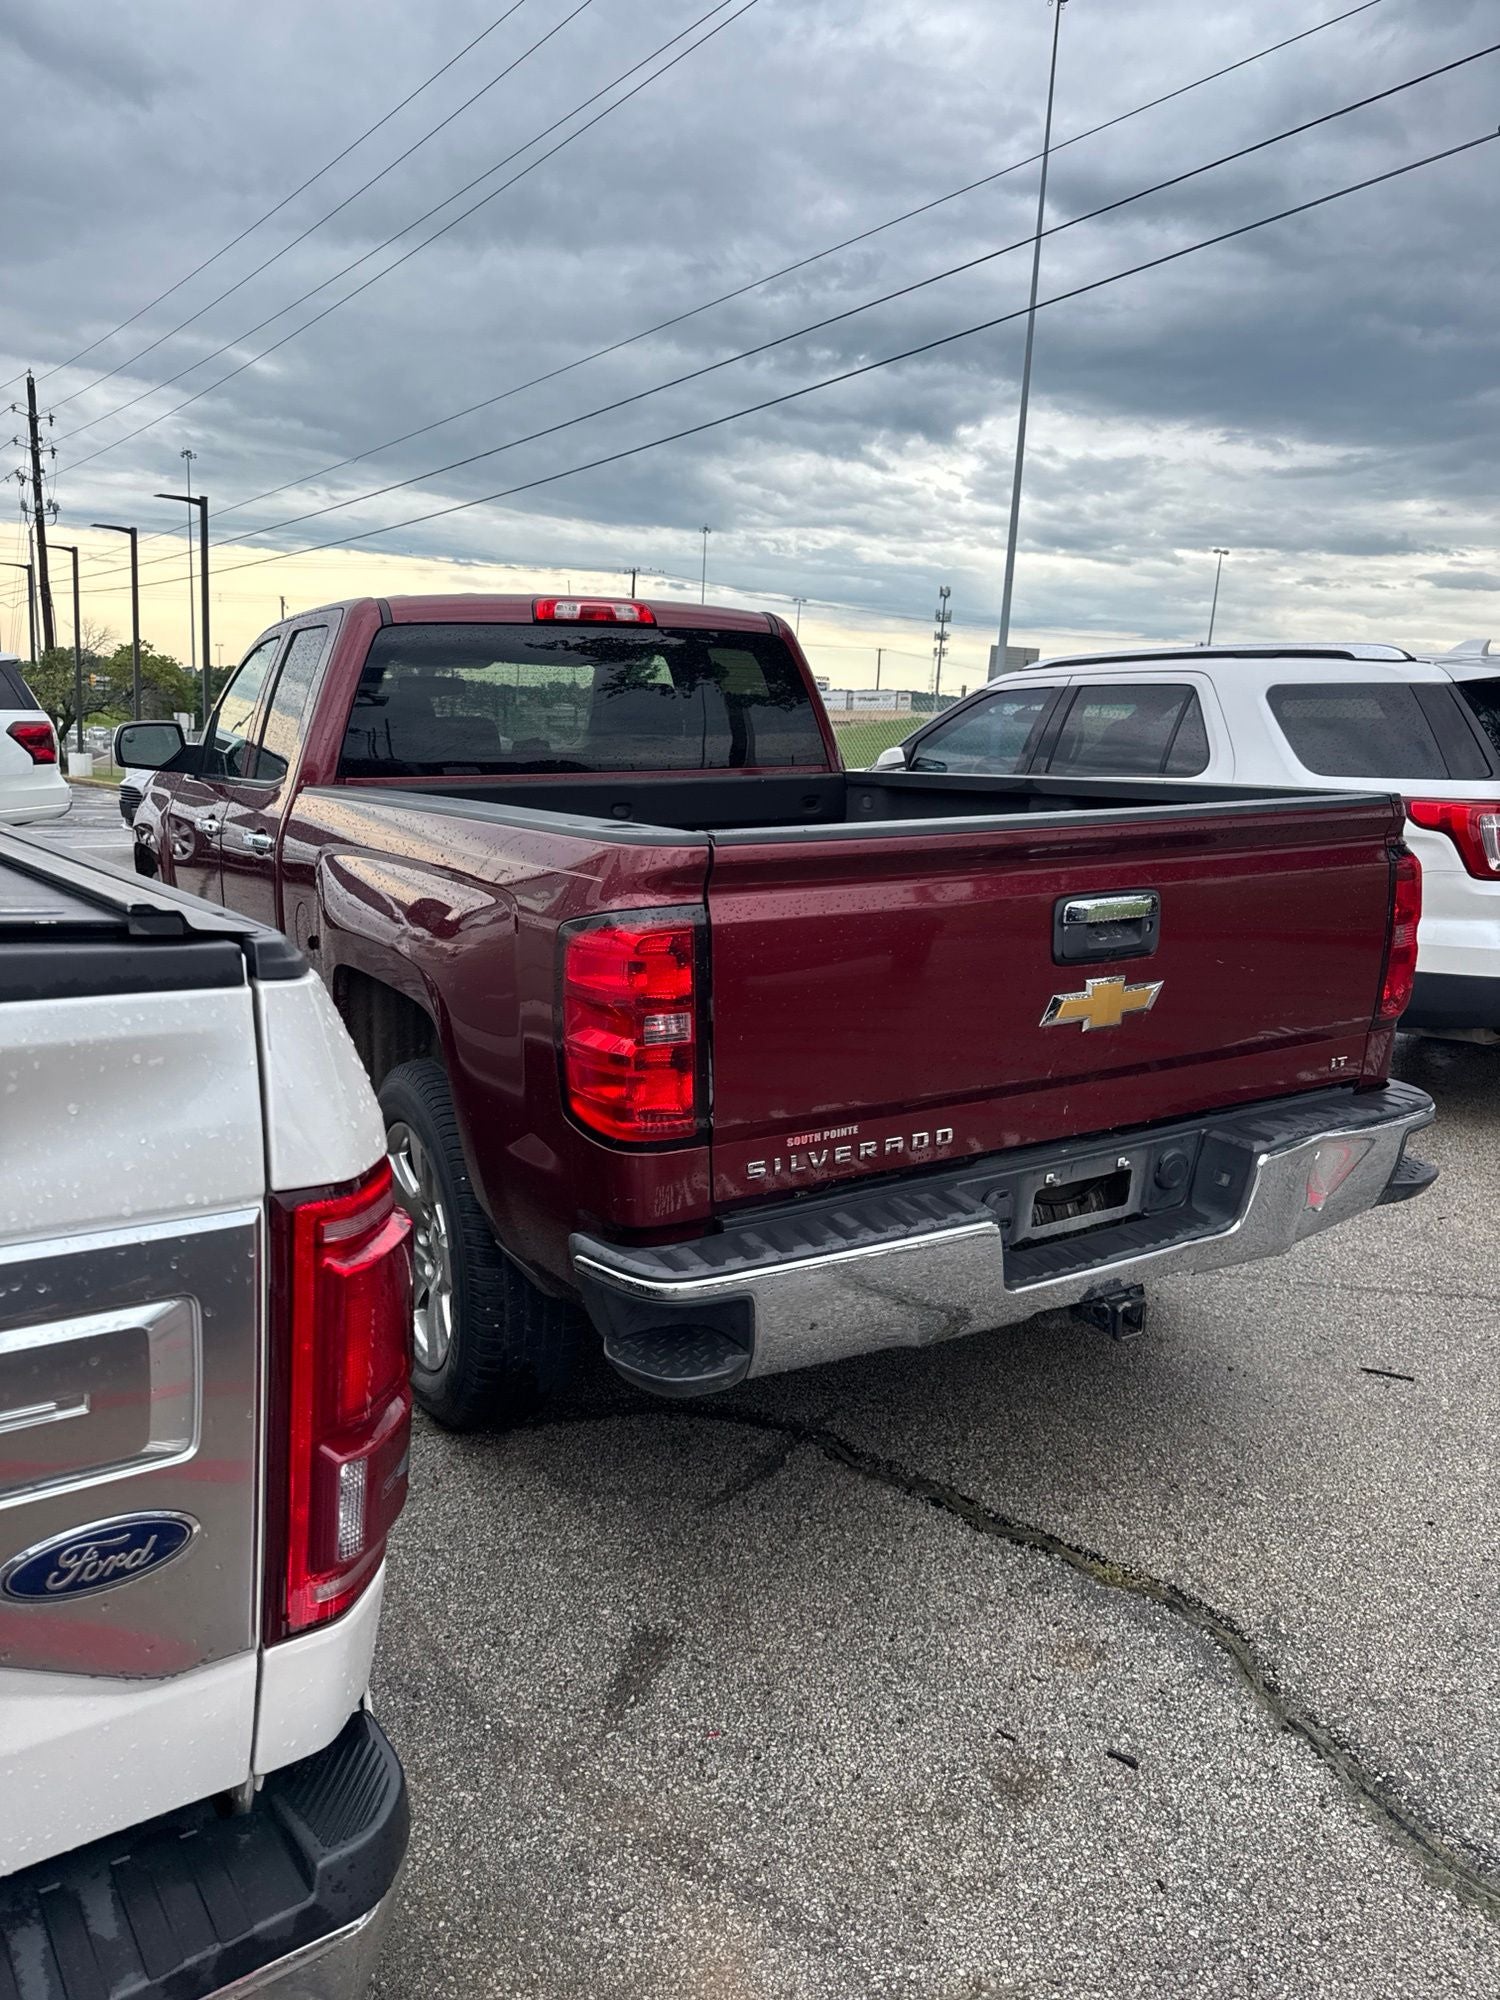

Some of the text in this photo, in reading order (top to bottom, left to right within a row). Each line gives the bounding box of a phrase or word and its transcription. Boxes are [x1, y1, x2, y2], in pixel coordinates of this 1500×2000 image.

[746, 1127, 954, 1180] SILVERADO
[786, 1125, 859, 1147] SOUTH POINTE
[45, 1533, 158, 1590] Ford
